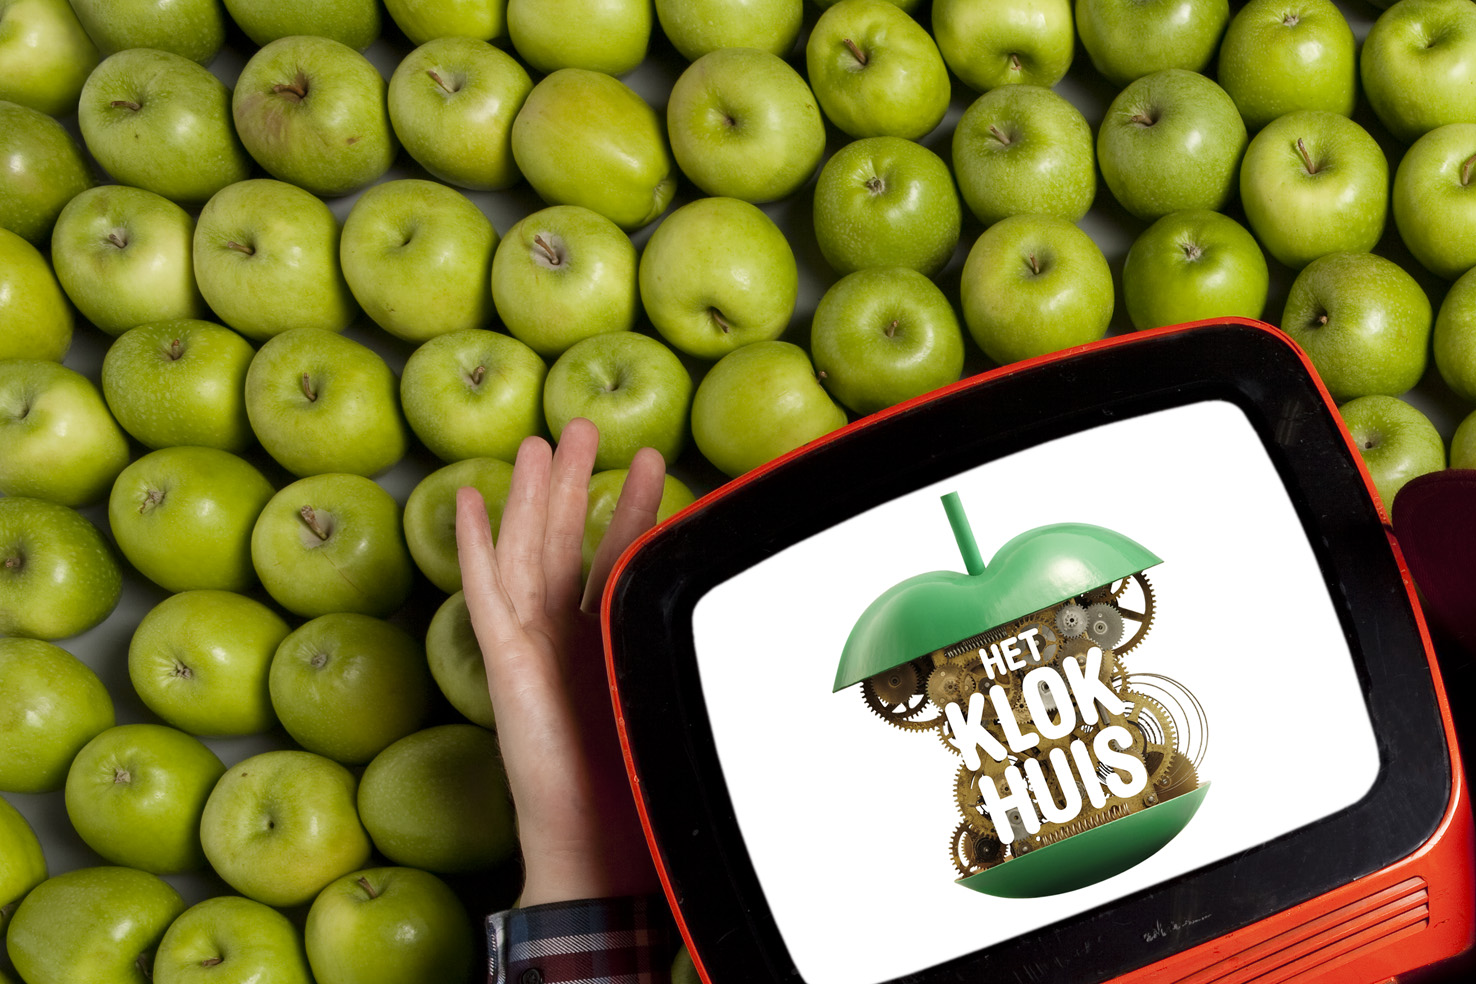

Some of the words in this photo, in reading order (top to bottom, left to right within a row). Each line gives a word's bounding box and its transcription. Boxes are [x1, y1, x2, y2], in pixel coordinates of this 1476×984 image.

[945, 646, 1125, 772] KLOK
[978, 628, 1039, 680] HET
[978, 725, 1148, 844] HUIS
